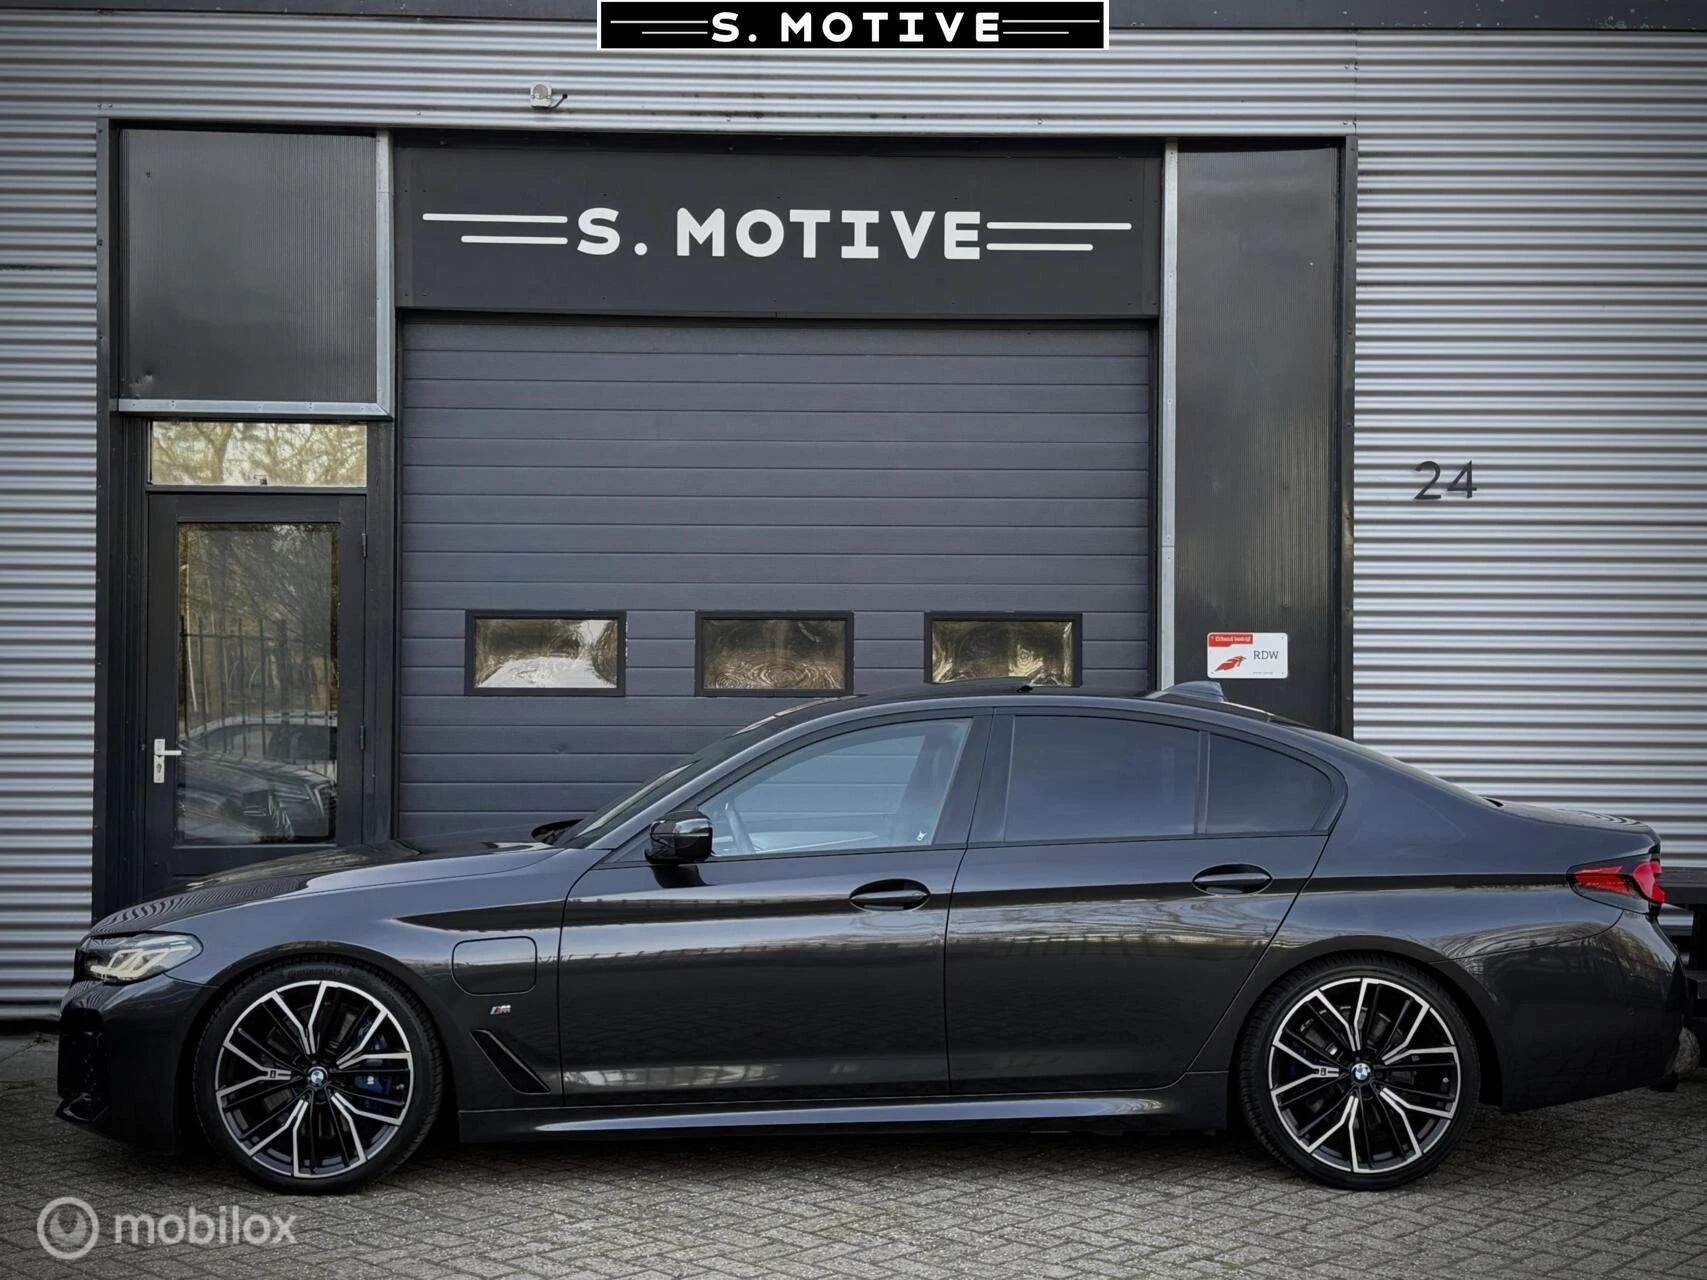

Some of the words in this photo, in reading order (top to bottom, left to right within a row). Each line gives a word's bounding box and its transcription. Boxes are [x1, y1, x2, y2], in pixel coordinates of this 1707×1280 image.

[576, 207, 648, 256] S.
[676, 207, 981, 260] MOTIVE
[1414, 460, 1477, 499] 24
[1253, 650, 1279, 660] RDW
